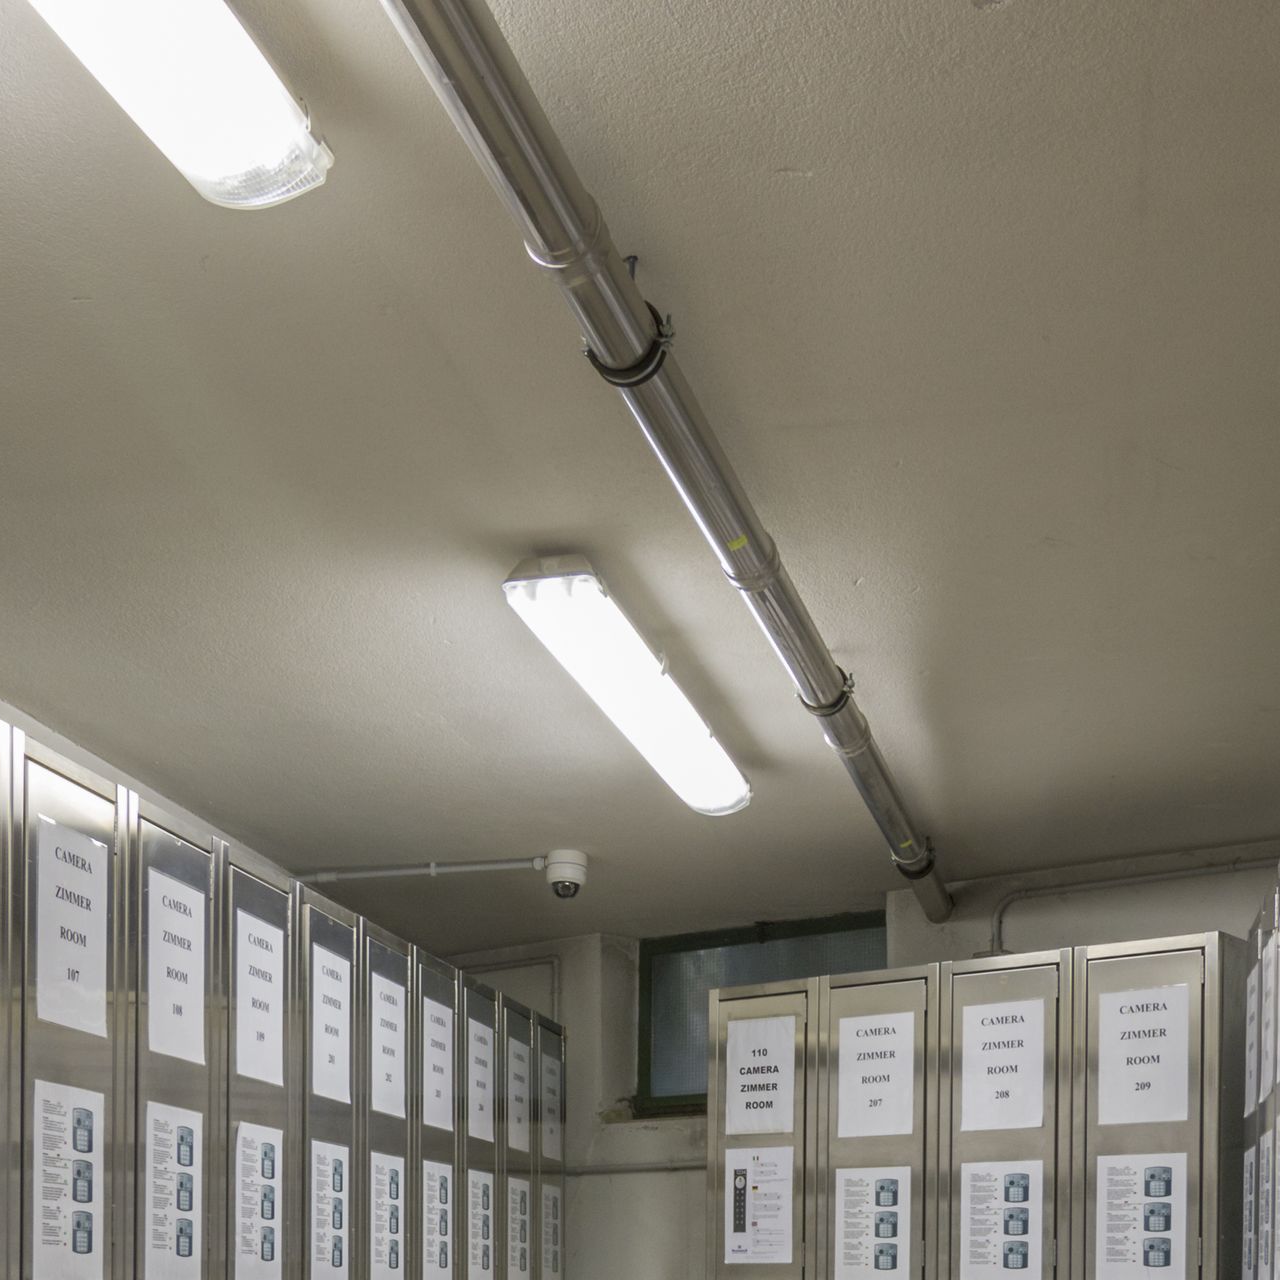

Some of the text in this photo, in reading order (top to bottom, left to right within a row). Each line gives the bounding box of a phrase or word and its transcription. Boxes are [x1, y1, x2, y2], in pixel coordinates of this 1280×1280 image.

[54, 846, 93, 875] CAMERA
[55, 884, 92, 912] ZIMMER
[161, 894, 193, 919] CAMERA
[59, 925, 87, 948] ROOM
[162, 929, 192, 952] ZIMMER
[247, 932, 274, 953] CAMERA
[67, 967, 80, 983] 107
[166, 965, 188, 985] ROOM
[248, 964, 273, 984] ZIMMER
[251, 996, 270, 1014] ROOM
[1119, 1002, 1168, 1015] CAMERA
[980, 1014, 1025, 1026] CAMERA
[855, 1026, 897, 1038] CAMERA
[1120, 1028, 1167, 1041] ZIMMER
[981, 1039, 1025, 1051] ZIMMER
[751, 1047, 768, 1058] 110
[856, 1050, 896, 1062] ZIMMER
[1126, 1054, 1161, 1066] ROOM
[739, 1064, 780, 1076] CAMERA
[987, 1064, 1018, 1076] ROOM
[861, 1073, 891, 1085] ROOM
[740, 1082, 778, 1093] ZIMMER
[1134, 1081, 1152, 1092] 209
[994, 1089, 1010, 1100] 208
[745, 1100, 774, 1110] ROOM
[868, 1098, 883, 1108] 207
